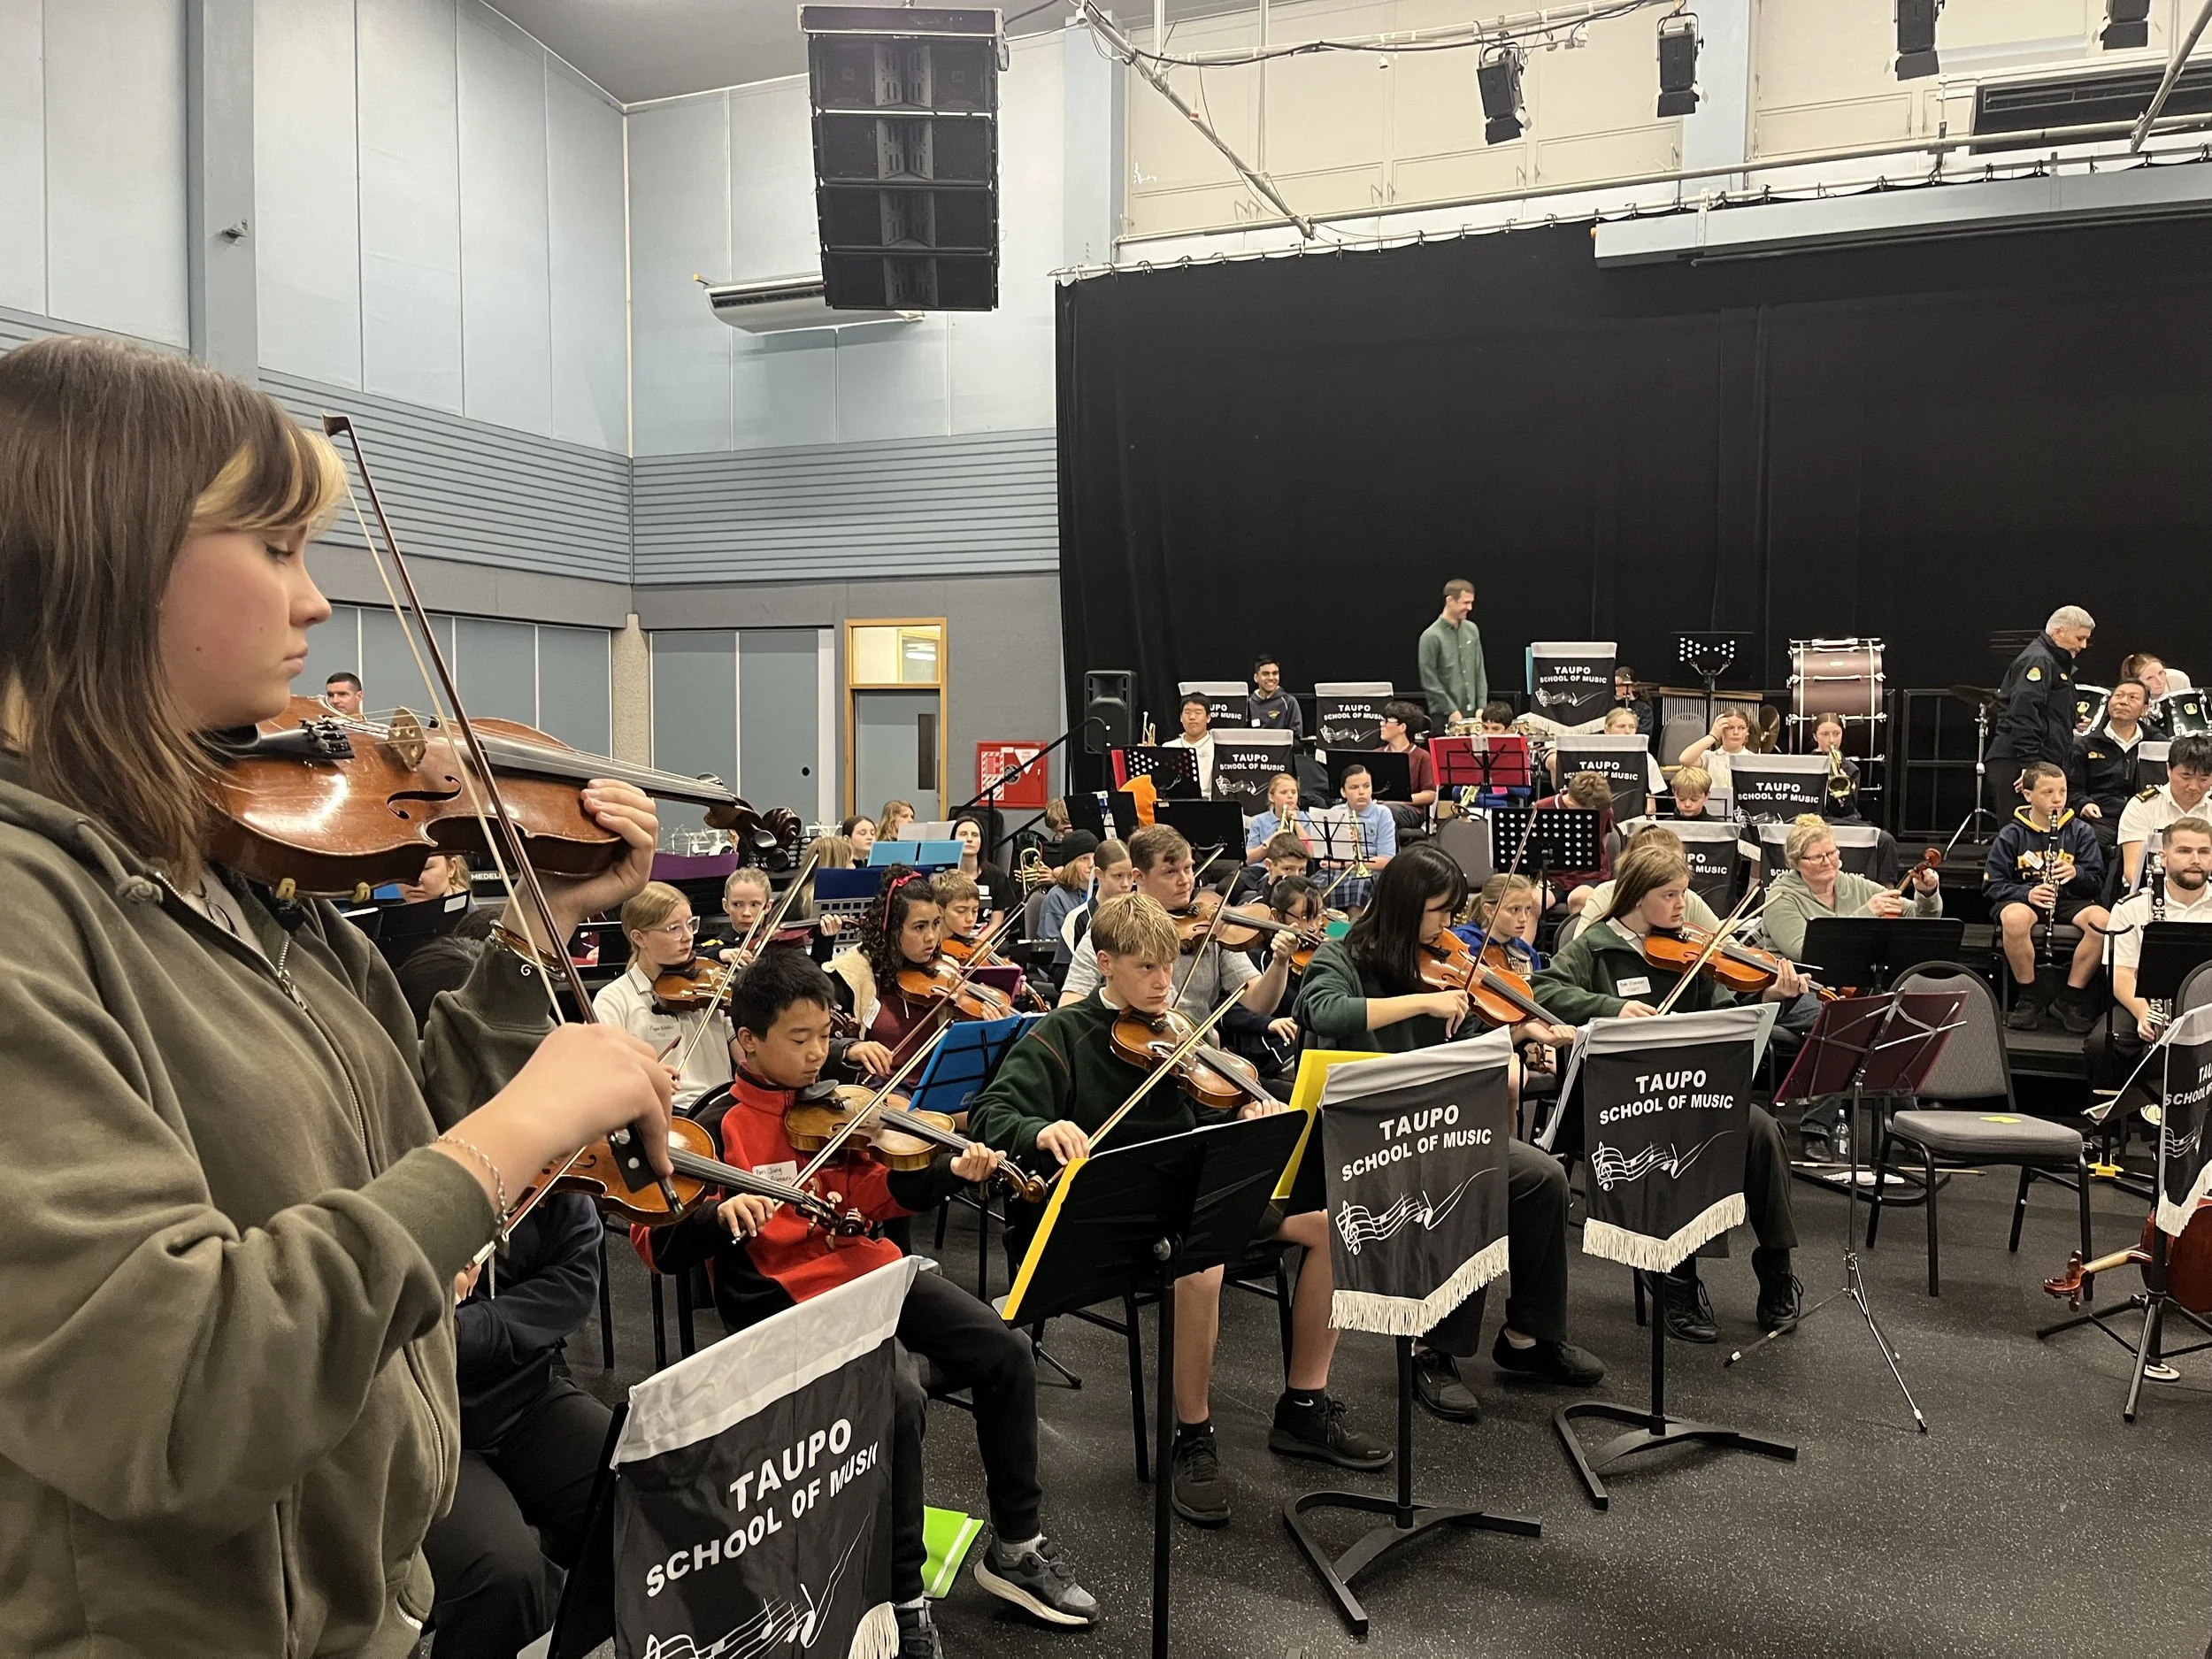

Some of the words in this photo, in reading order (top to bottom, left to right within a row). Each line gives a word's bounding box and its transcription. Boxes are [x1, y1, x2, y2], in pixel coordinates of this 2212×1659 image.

[1554, 666, 1591, 675] TAUPO
[1540, 675, 1569, 684] SCHOOL
[1324, 712, 1351, 721] SCHOOL
[1232, 753, 1269, 763] TAUPO
[1578, 761, 1620, 771] TAUPO
[1610, 772, 1639, 780] MUSIC
[1755, 782, 1801, 793] TAUPO
[1790, 794, 1820, 803] MUSIC
[1695, 864, 1728, 875] MUSIC
[2199, 1063, 2212, 1084] TAU
[1635, 1070, 1707, 1094] TAUPO
[1599, 1097, 1663, 1125] SCHOOL
[1668, 1094, 1687, 1110] OF
[1691, 1094, 1734, 1110] MUSIC
[1379, 1104, 1460, 1141] TAUPO
[1341, 1142, 1413, 1182] SCHOOL
[1417, 1134, 1439, 1154] OF
[1443, 1128, 1493, 1148] MUSIC
[729, 1418, 852, 1513] TAUPO
[646, 1507, 782, 1598] SCHOOL
[791, 1478, 821, 1519] OF
